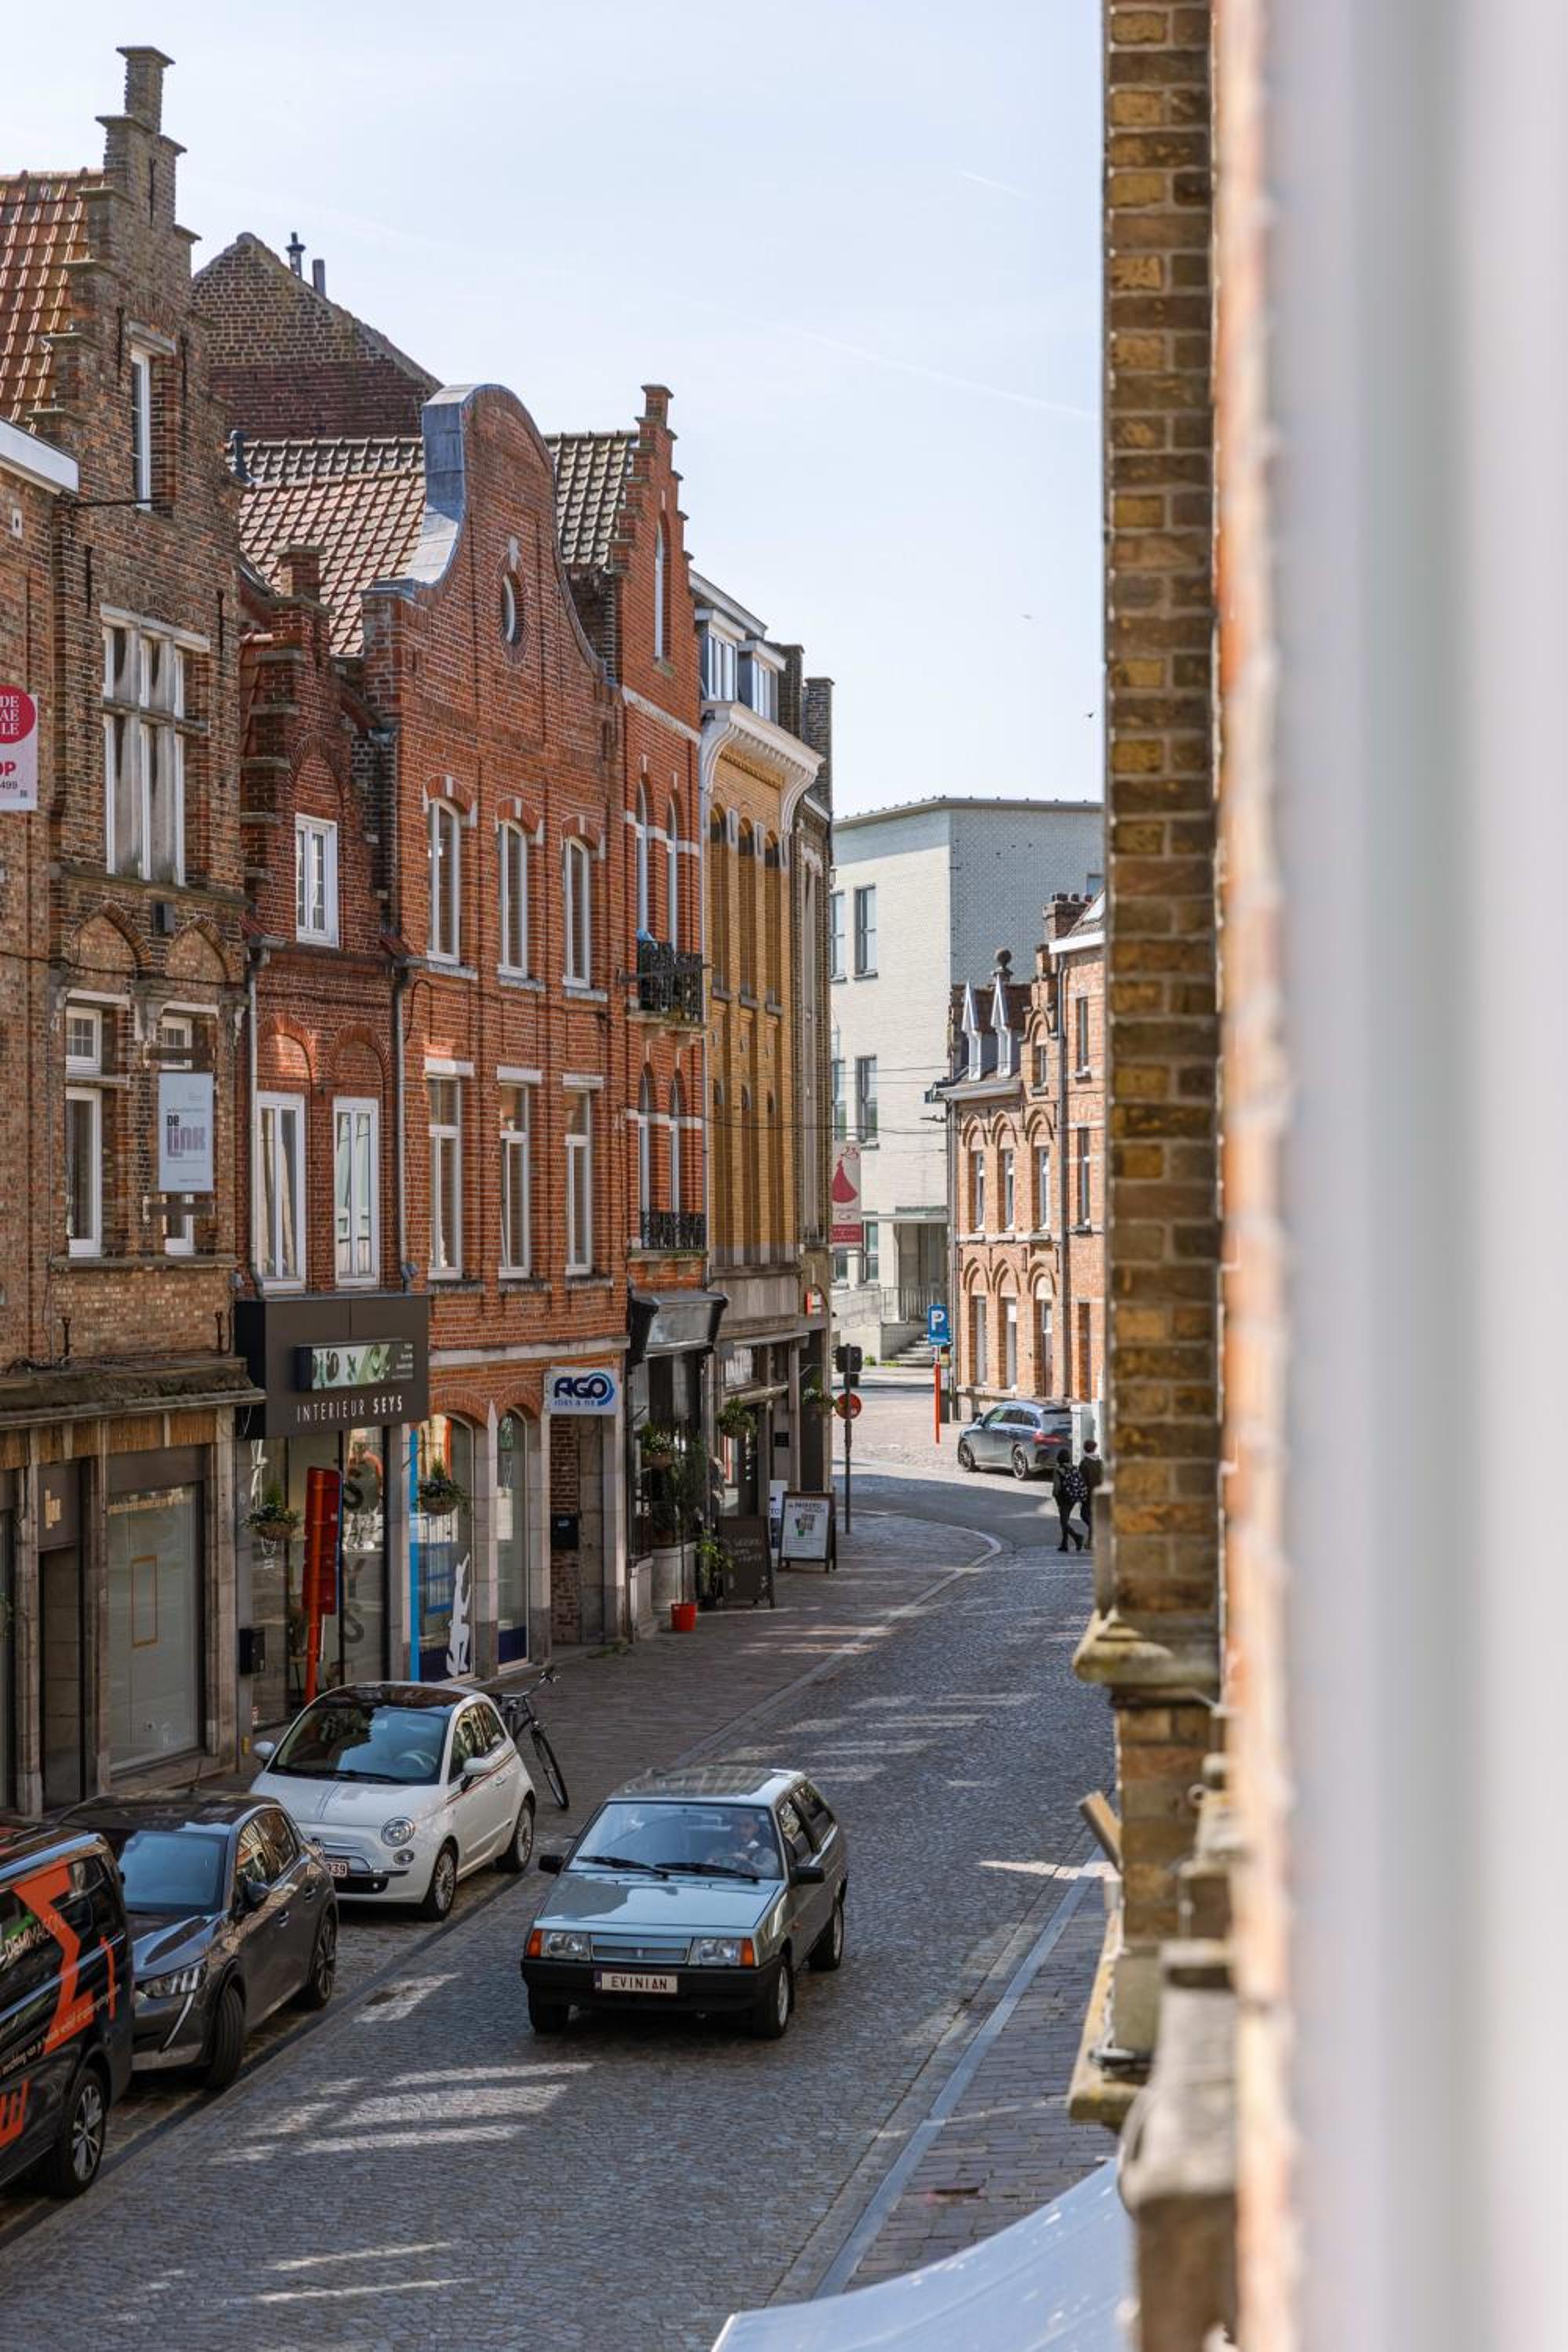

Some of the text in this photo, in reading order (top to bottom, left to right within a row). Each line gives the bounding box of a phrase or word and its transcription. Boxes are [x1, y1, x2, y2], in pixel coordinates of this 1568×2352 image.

[931, 1310, 945, 1330] P
[554, 1376, 608, 1399] AGO
[296, 1395, 402, 1423] INTERIEUR SEYS
[612, 1976, 667, 1990] EVINIAN
